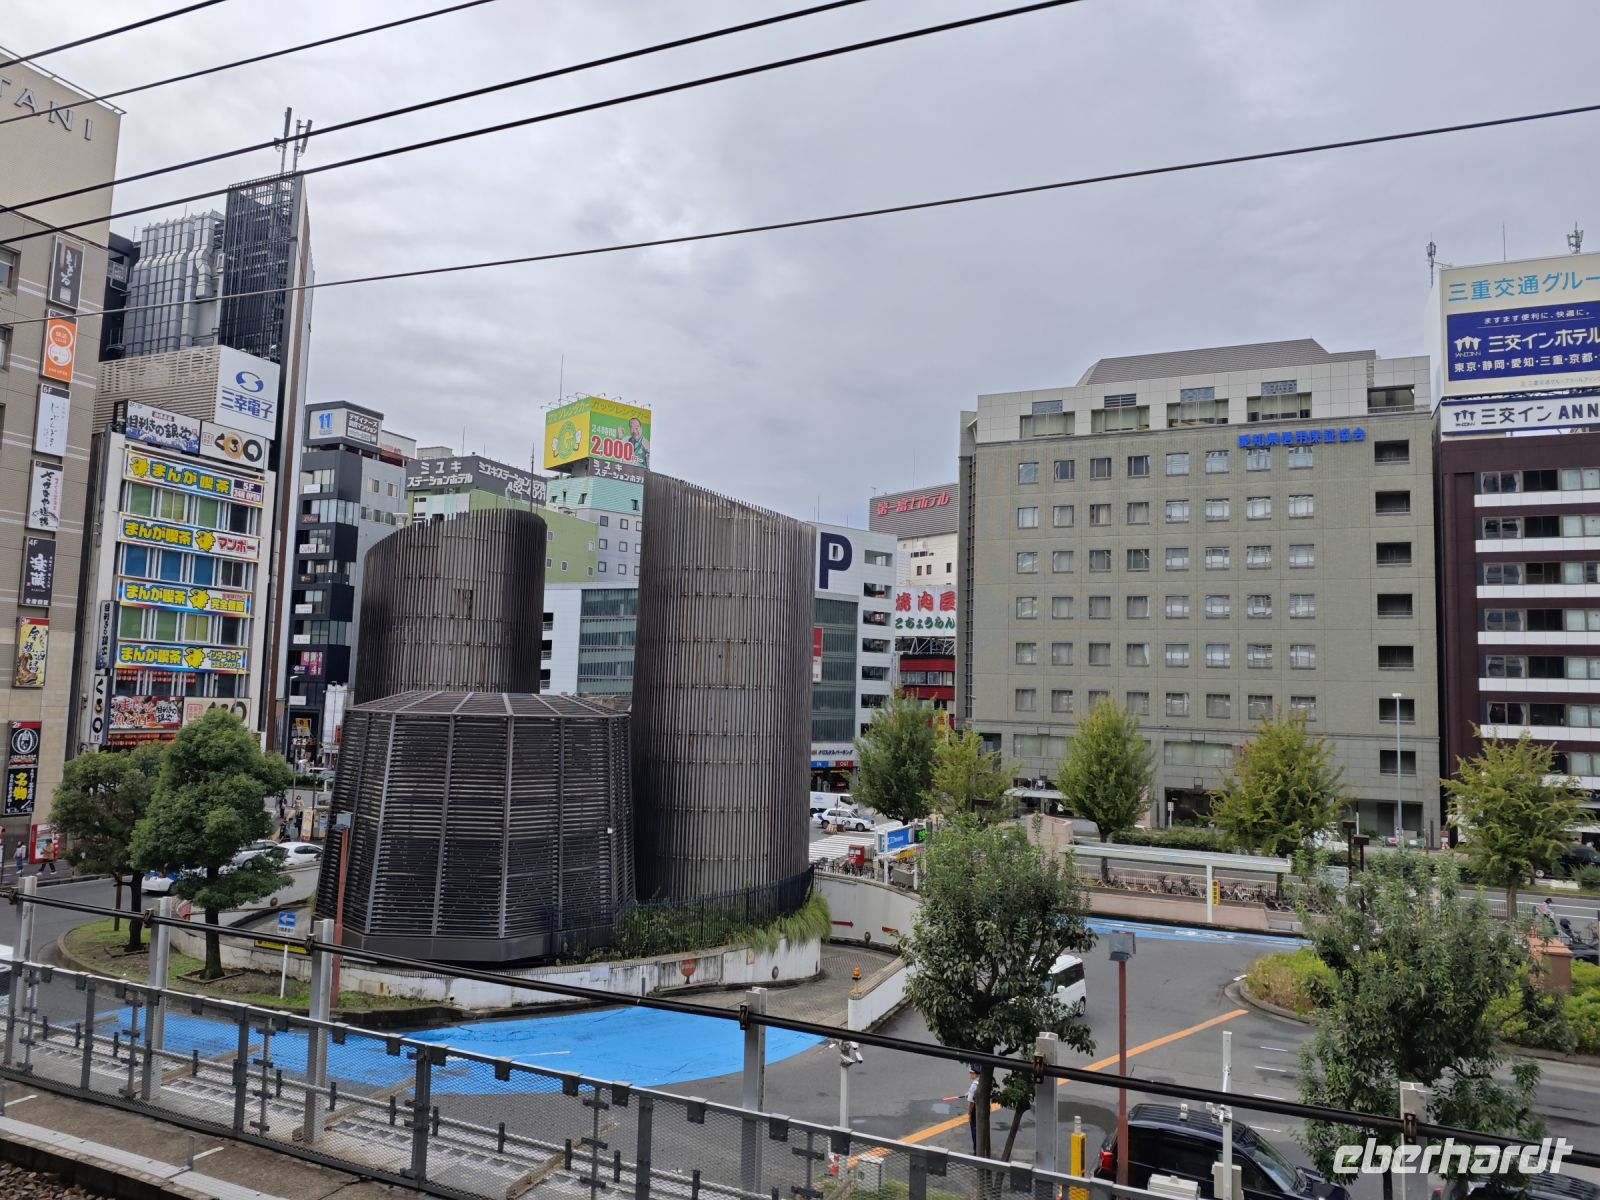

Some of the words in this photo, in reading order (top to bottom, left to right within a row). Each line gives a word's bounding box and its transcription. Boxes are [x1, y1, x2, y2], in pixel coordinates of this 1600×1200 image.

[1488, 327, 1600, 353] 三交インホテル
[1454, 353, 1600, 373] 東京・静岡・愛知・三重・京都・
[220, 389, 273, 420] 三幸電子
[1481, 406, 1553, 426] 三交イン
[1558, 403, 1600, 421] ANN
[318, 412, 333, 430] 11
[152, 463, 230, 494] まんが喫茶
[407, 473, 473, 488] ステーションホテル
[875, 491, 949, 517] 第一富士ホテル
[125, 521, 192, 545] まんが喫茶
[218, 536, 256, 552] マンボー
[819, 532, 853, 589] P
[126, 585, 186, 604] まんが喫茶
[121, 647, 182, 665] まんが喫茶
